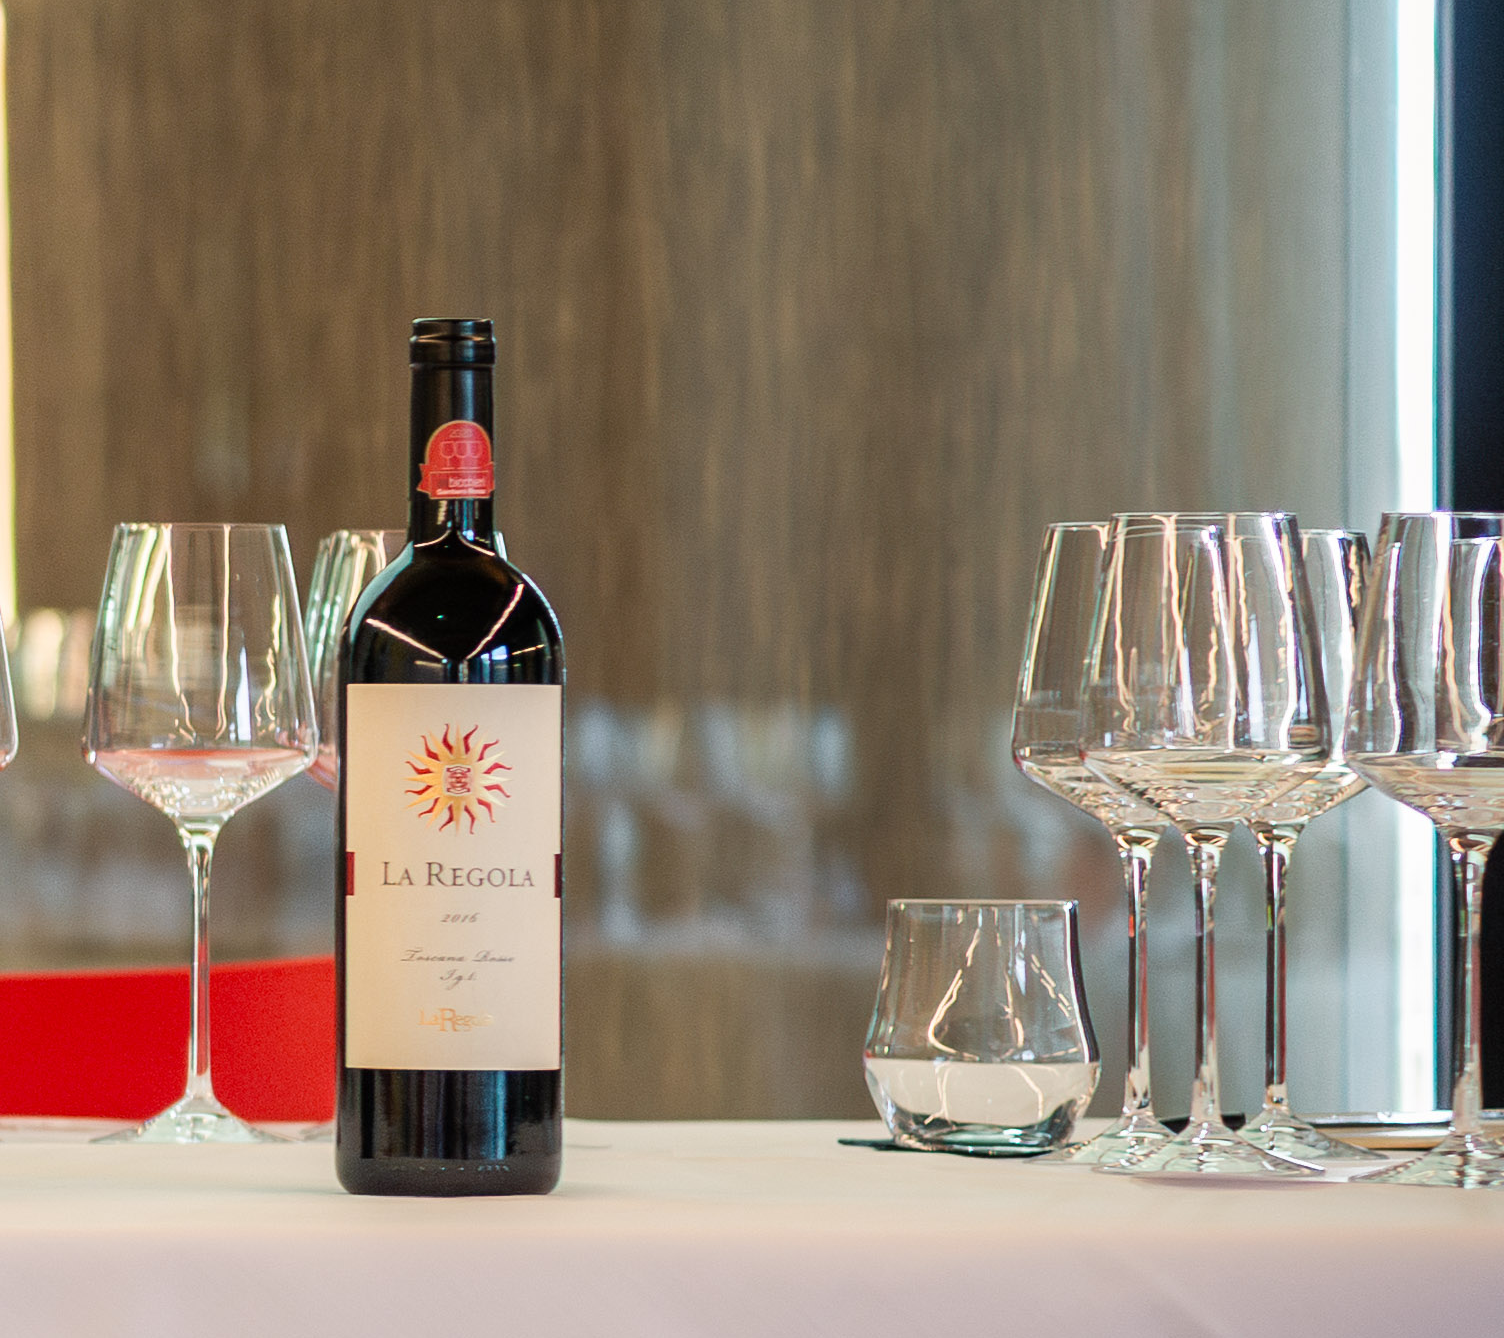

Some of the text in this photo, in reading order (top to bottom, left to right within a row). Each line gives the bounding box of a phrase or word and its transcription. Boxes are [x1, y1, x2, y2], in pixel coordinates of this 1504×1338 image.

[382, 861, 535, 887] LA REGOLA
[440, 912, 480, 923] 2016
